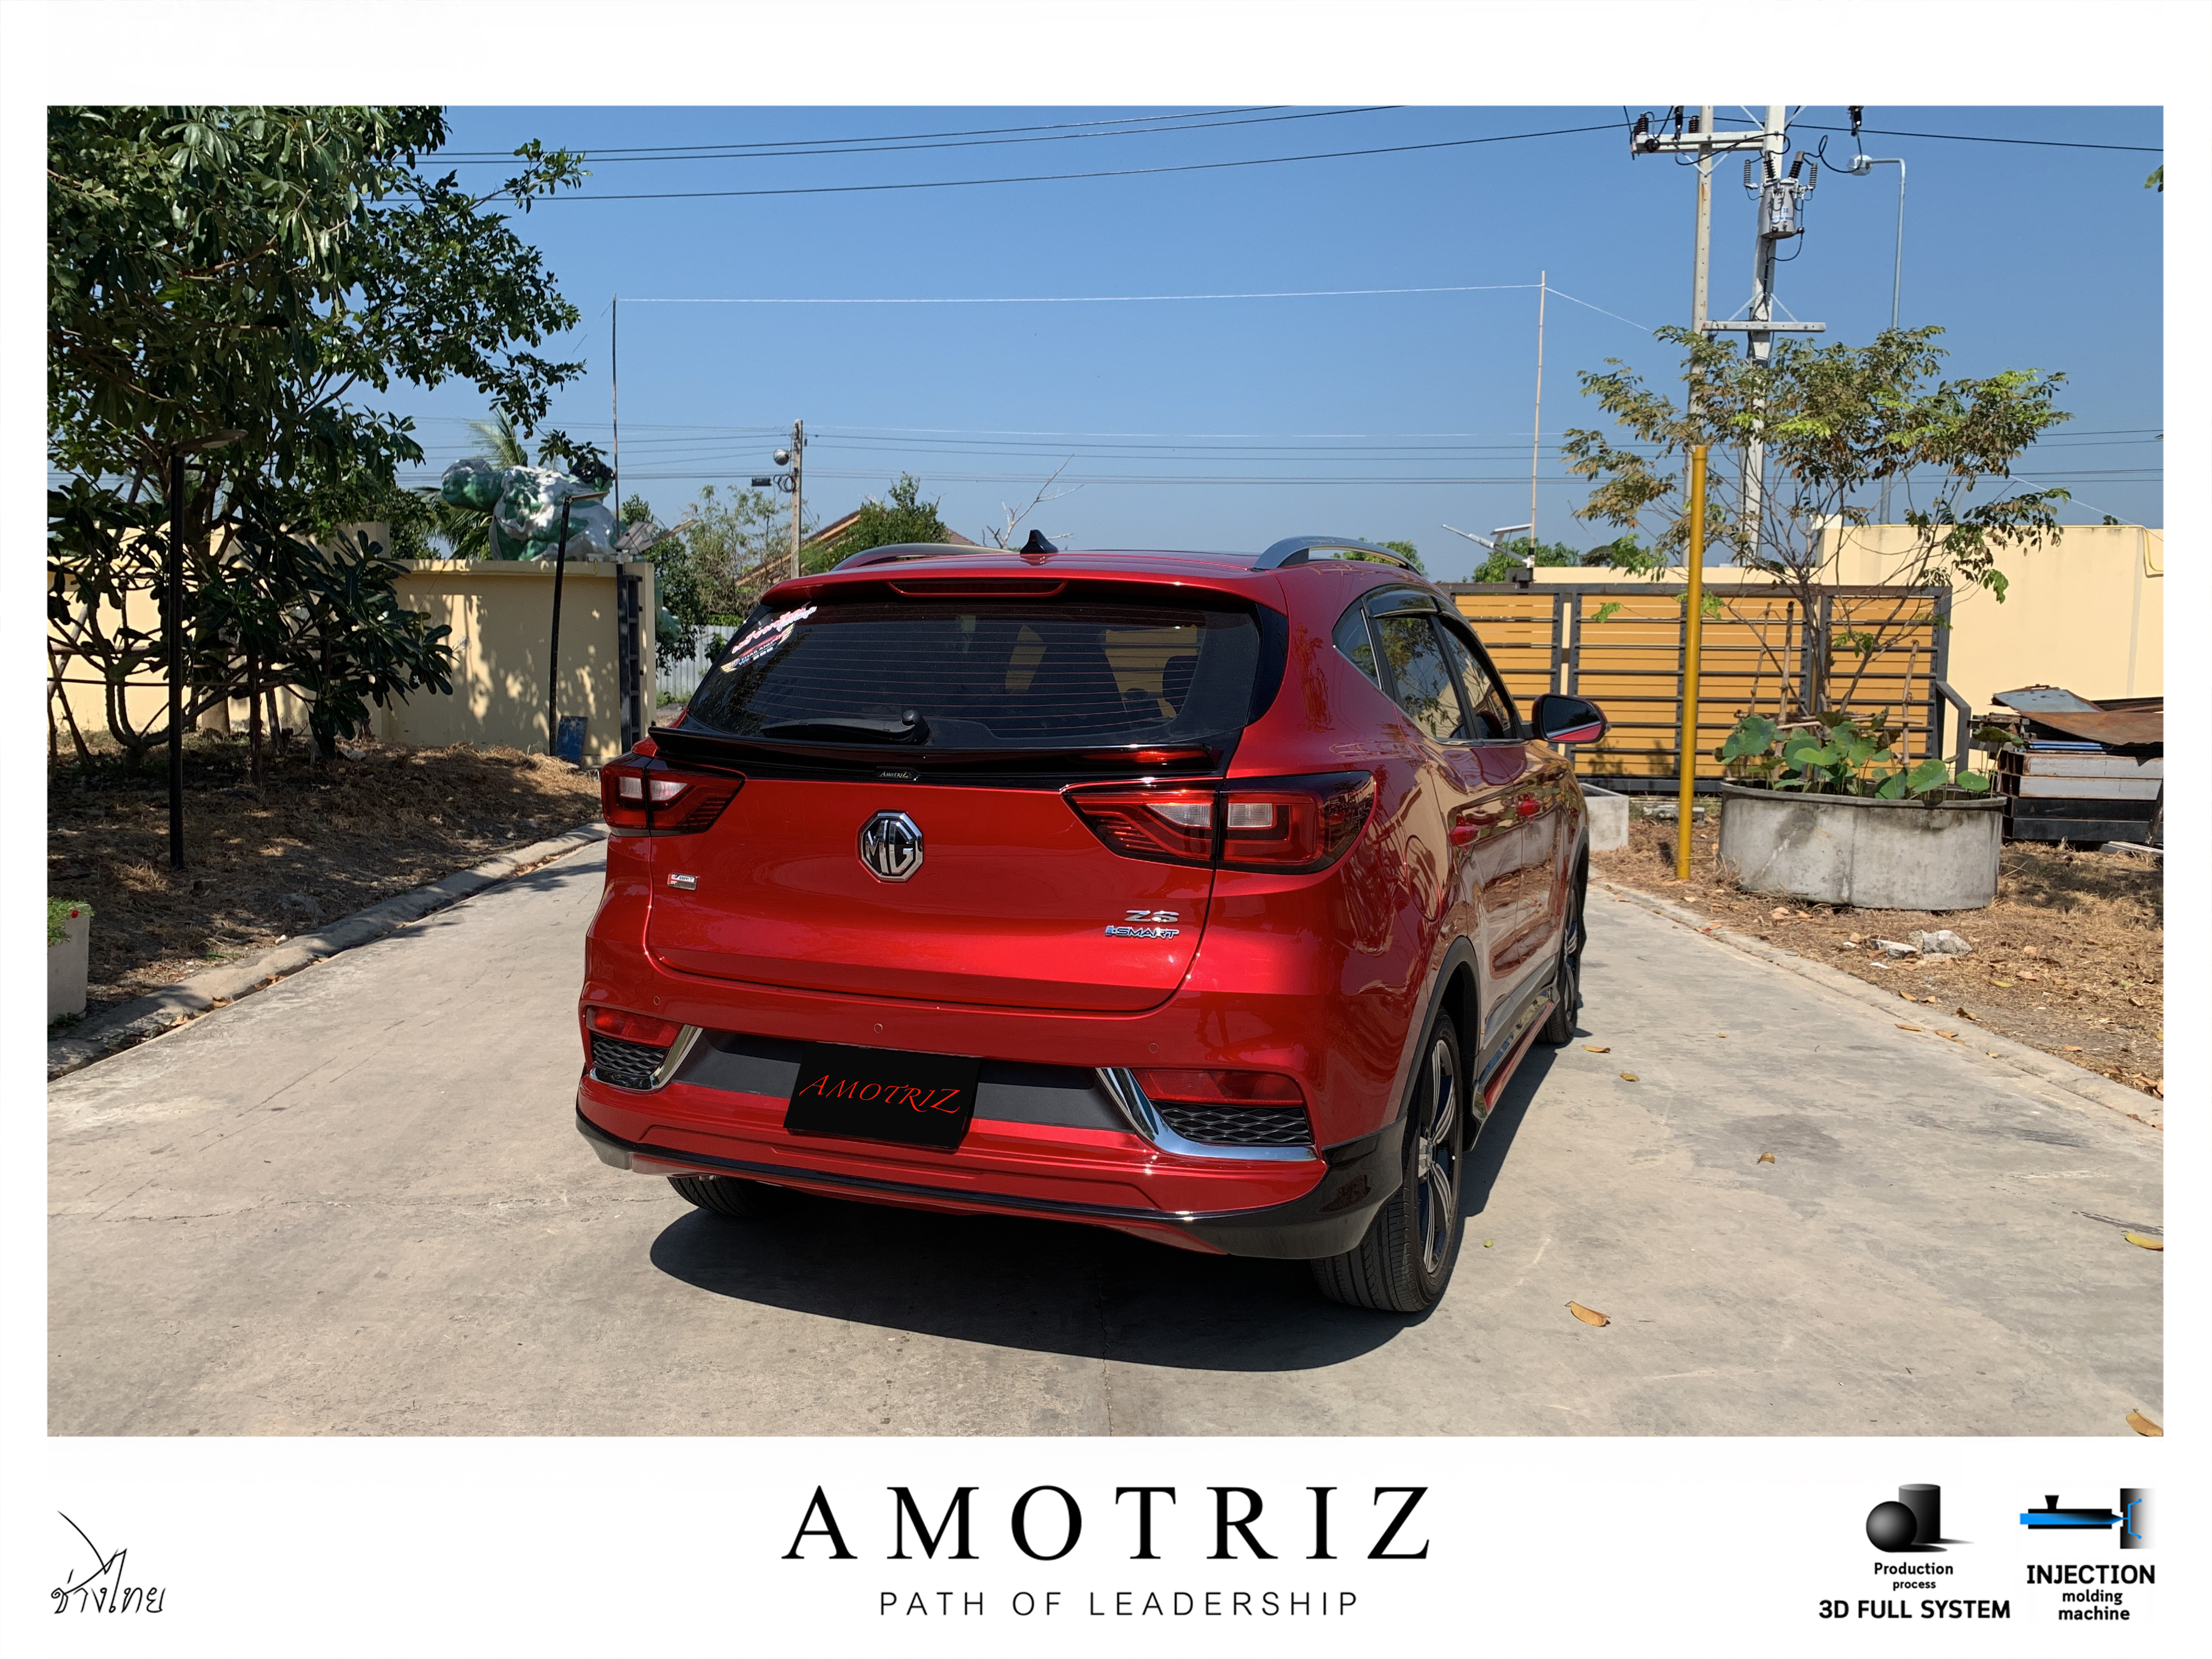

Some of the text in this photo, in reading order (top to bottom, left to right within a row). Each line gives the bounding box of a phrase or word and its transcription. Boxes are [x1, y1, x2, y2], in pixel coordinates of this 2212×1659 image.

[879, 771, 909, 779] AMOTRIZ
[865, 819, 913, 874] MG
[1124, 909, 1180, 922] ZS
